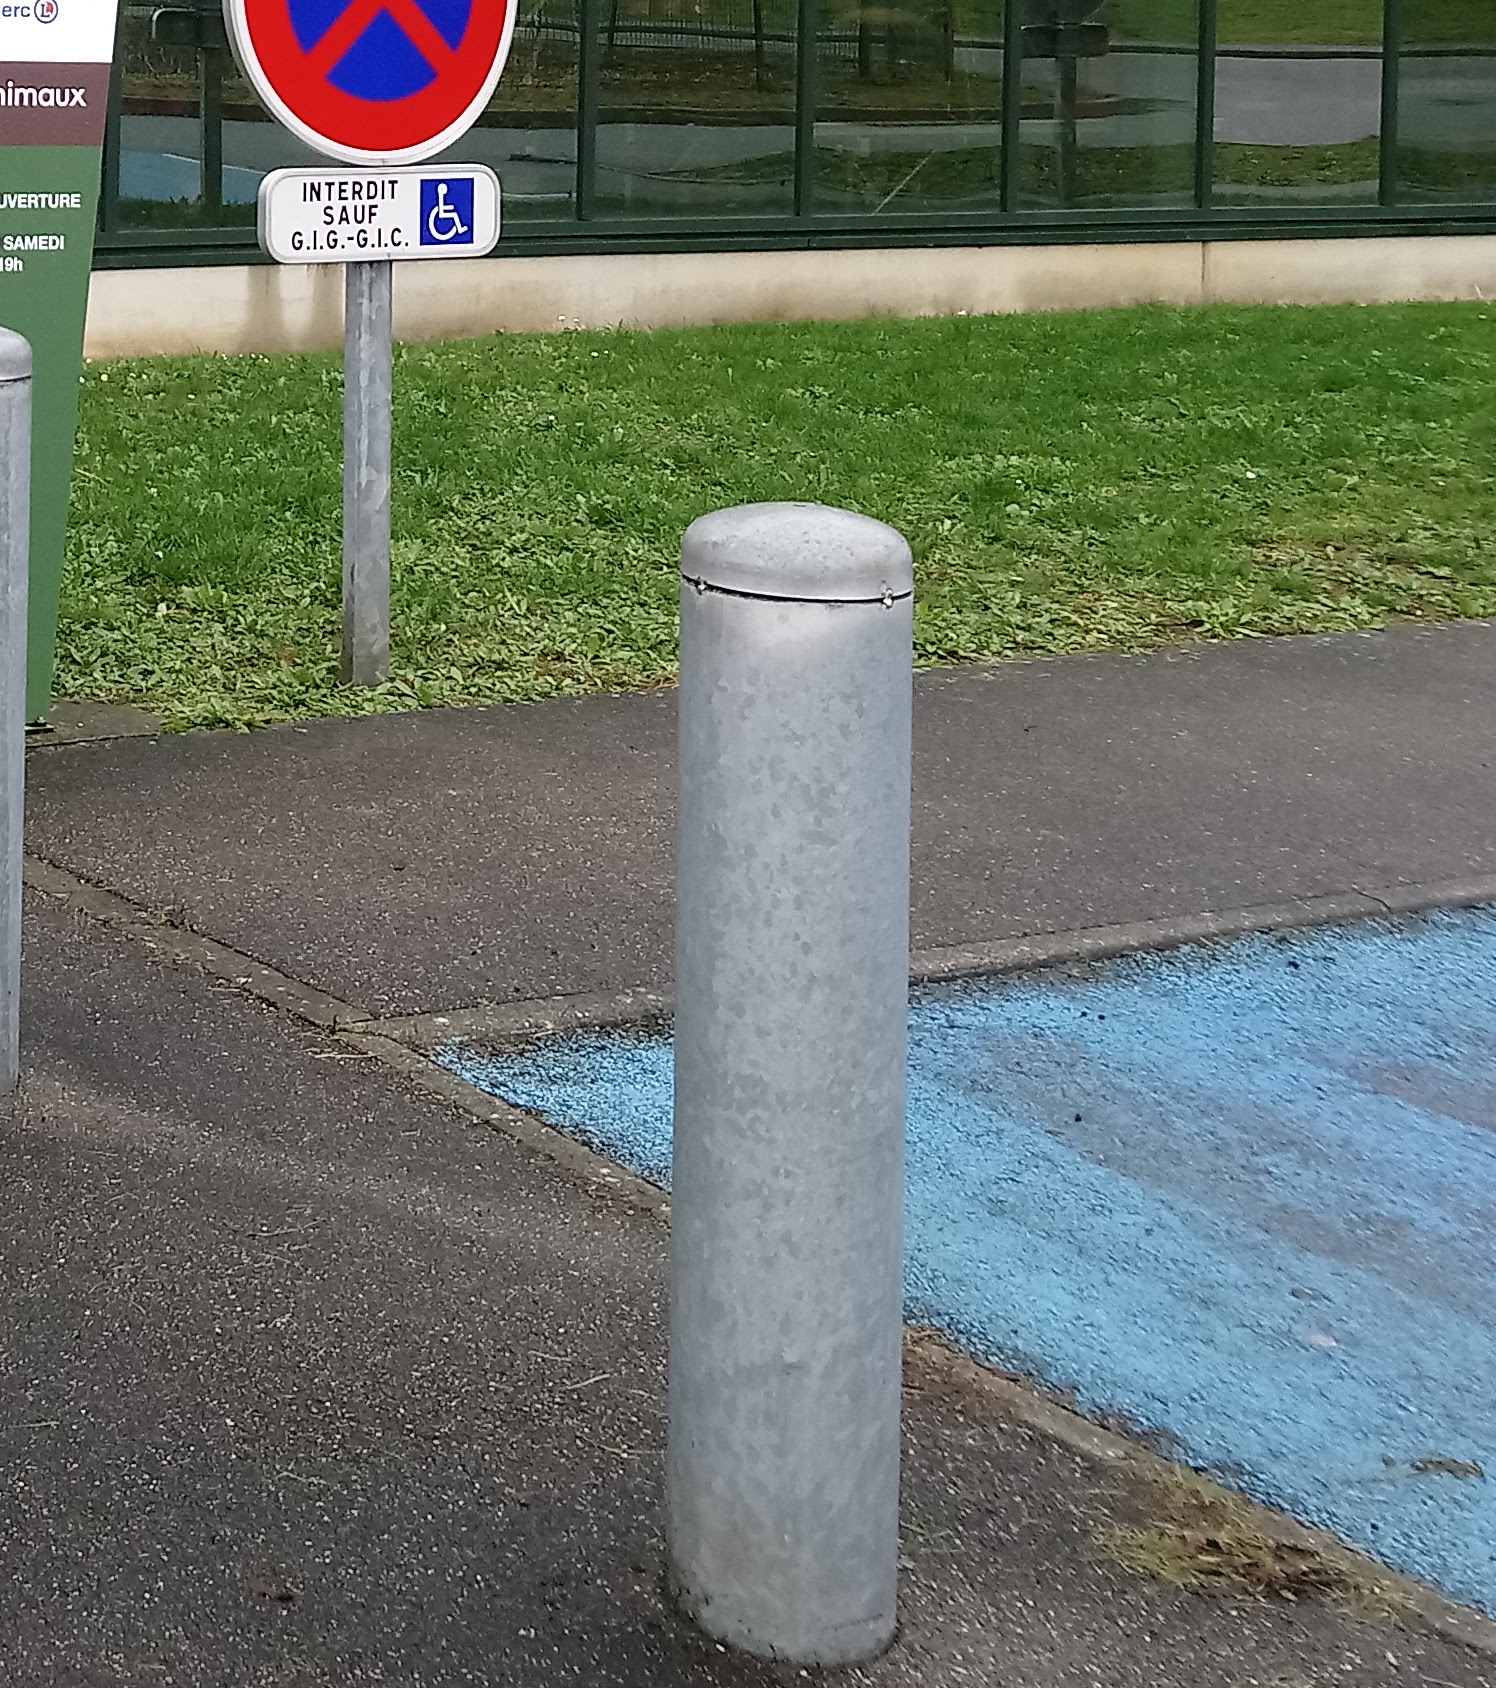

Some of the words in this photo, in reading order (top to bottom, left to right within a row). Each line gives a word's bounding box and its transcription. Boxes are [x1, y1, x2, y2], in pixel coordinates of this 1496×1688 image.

[302, 179, 399, 202] INTERDIT
[322, 204, 379, 225] SAUF
[3, 235, 65, 251] SAMEDI
[291, 227, 410, 251] G.I.G.-G.I.C.
